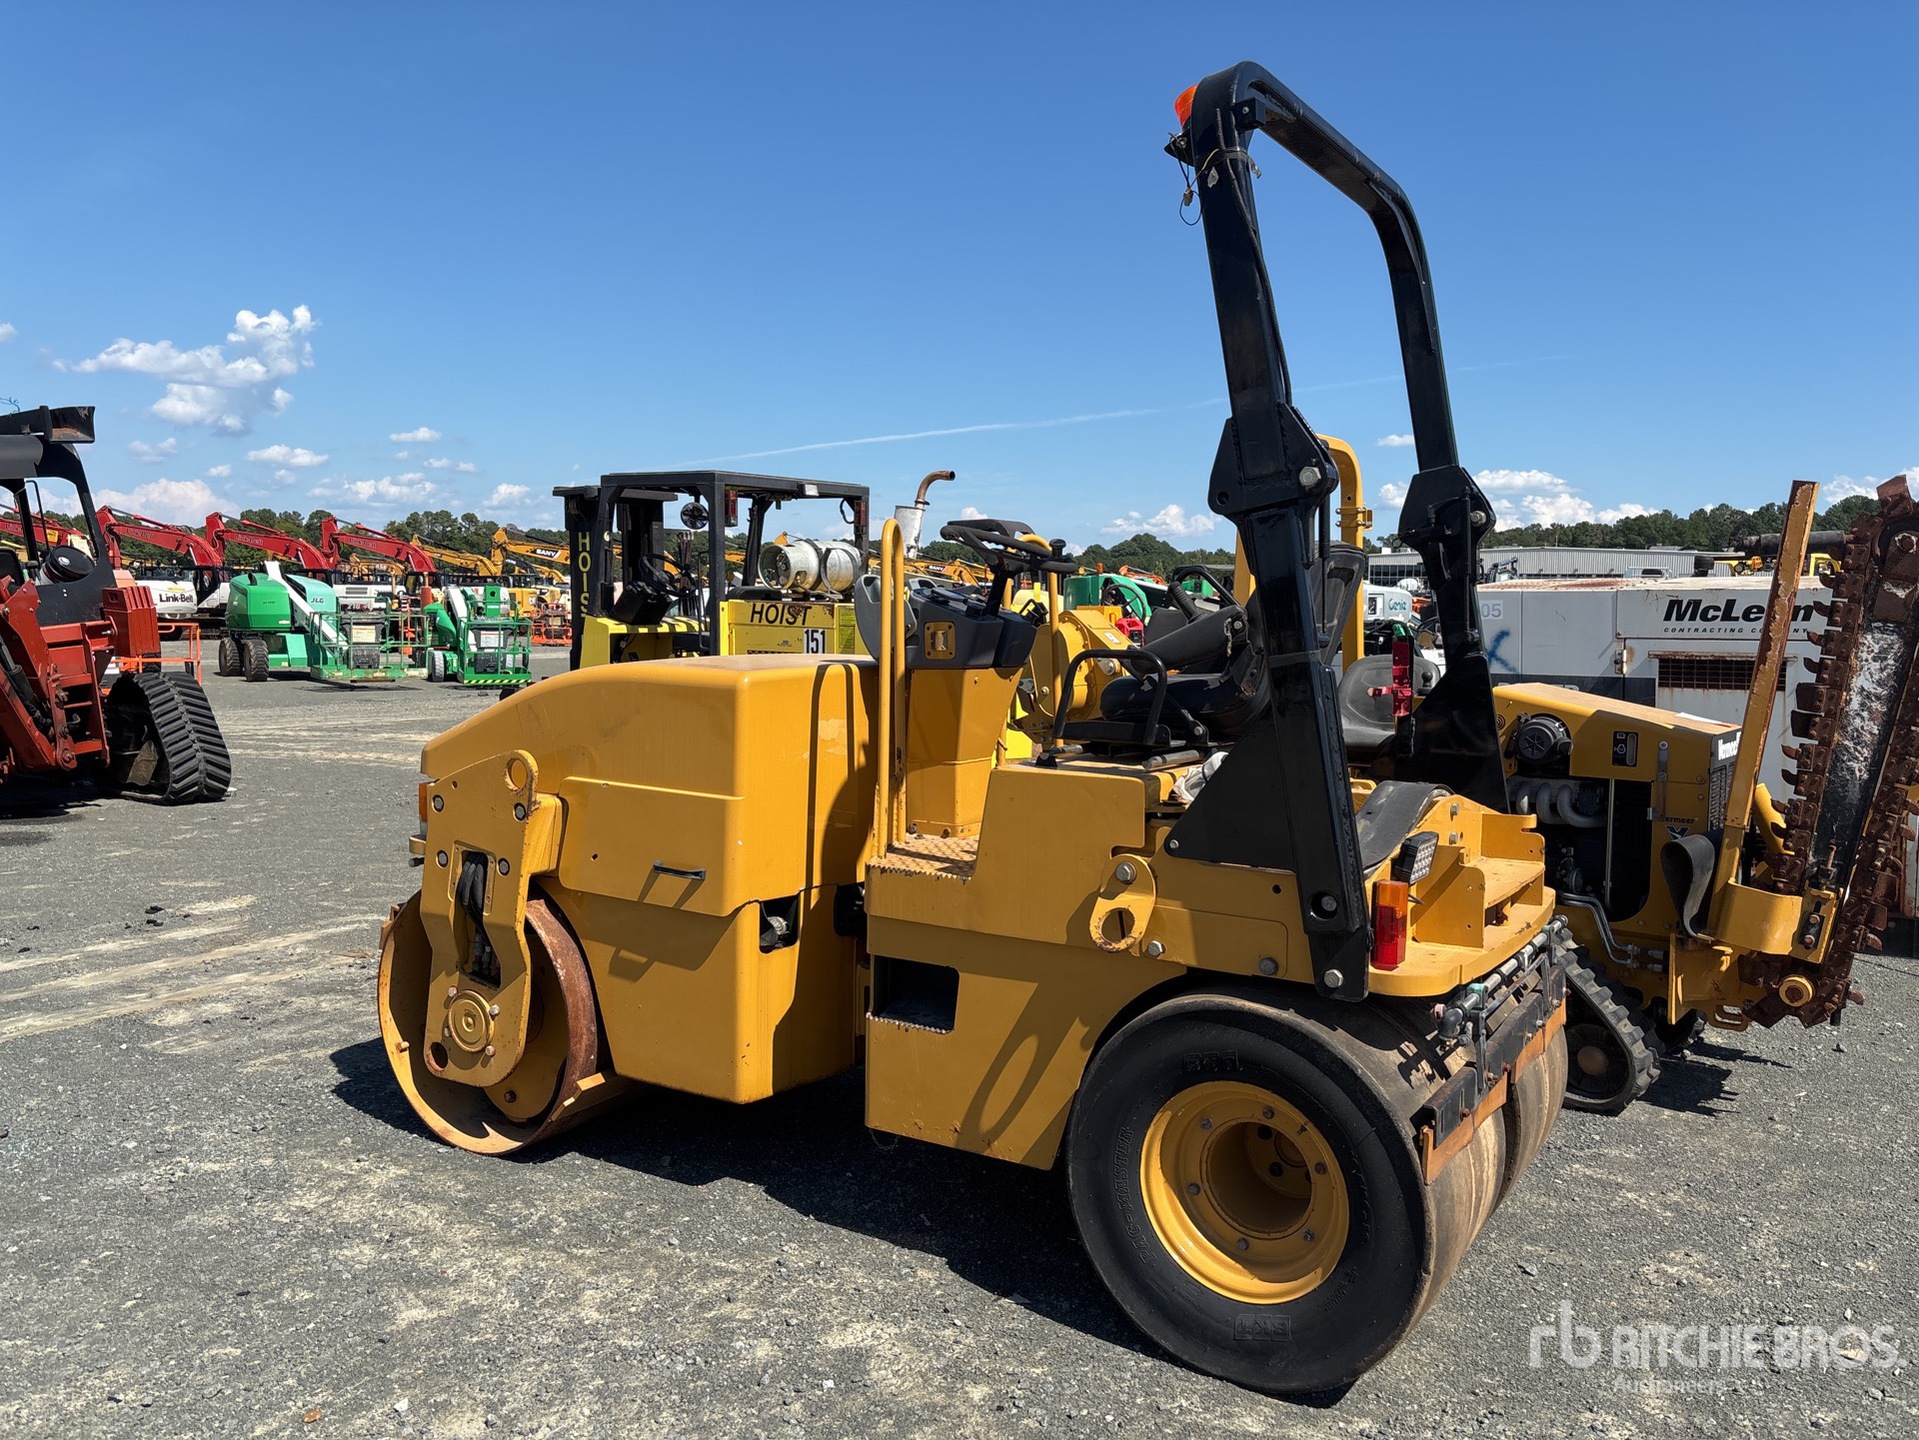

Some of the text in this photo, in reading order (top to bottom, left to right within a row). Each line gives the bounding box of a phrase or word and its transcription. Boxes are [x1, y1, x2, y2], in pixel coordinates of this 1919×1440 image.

[159, 593, 194, 603] Link-Belt
[1388, 599, 1407, 611] Genie
[750, 603, 813, 626] HOIST
[1663, 599, 1816, 622] McLen
[804, 629, 826, 654] 151
[1664, 816, 1696, 824] ermeer
